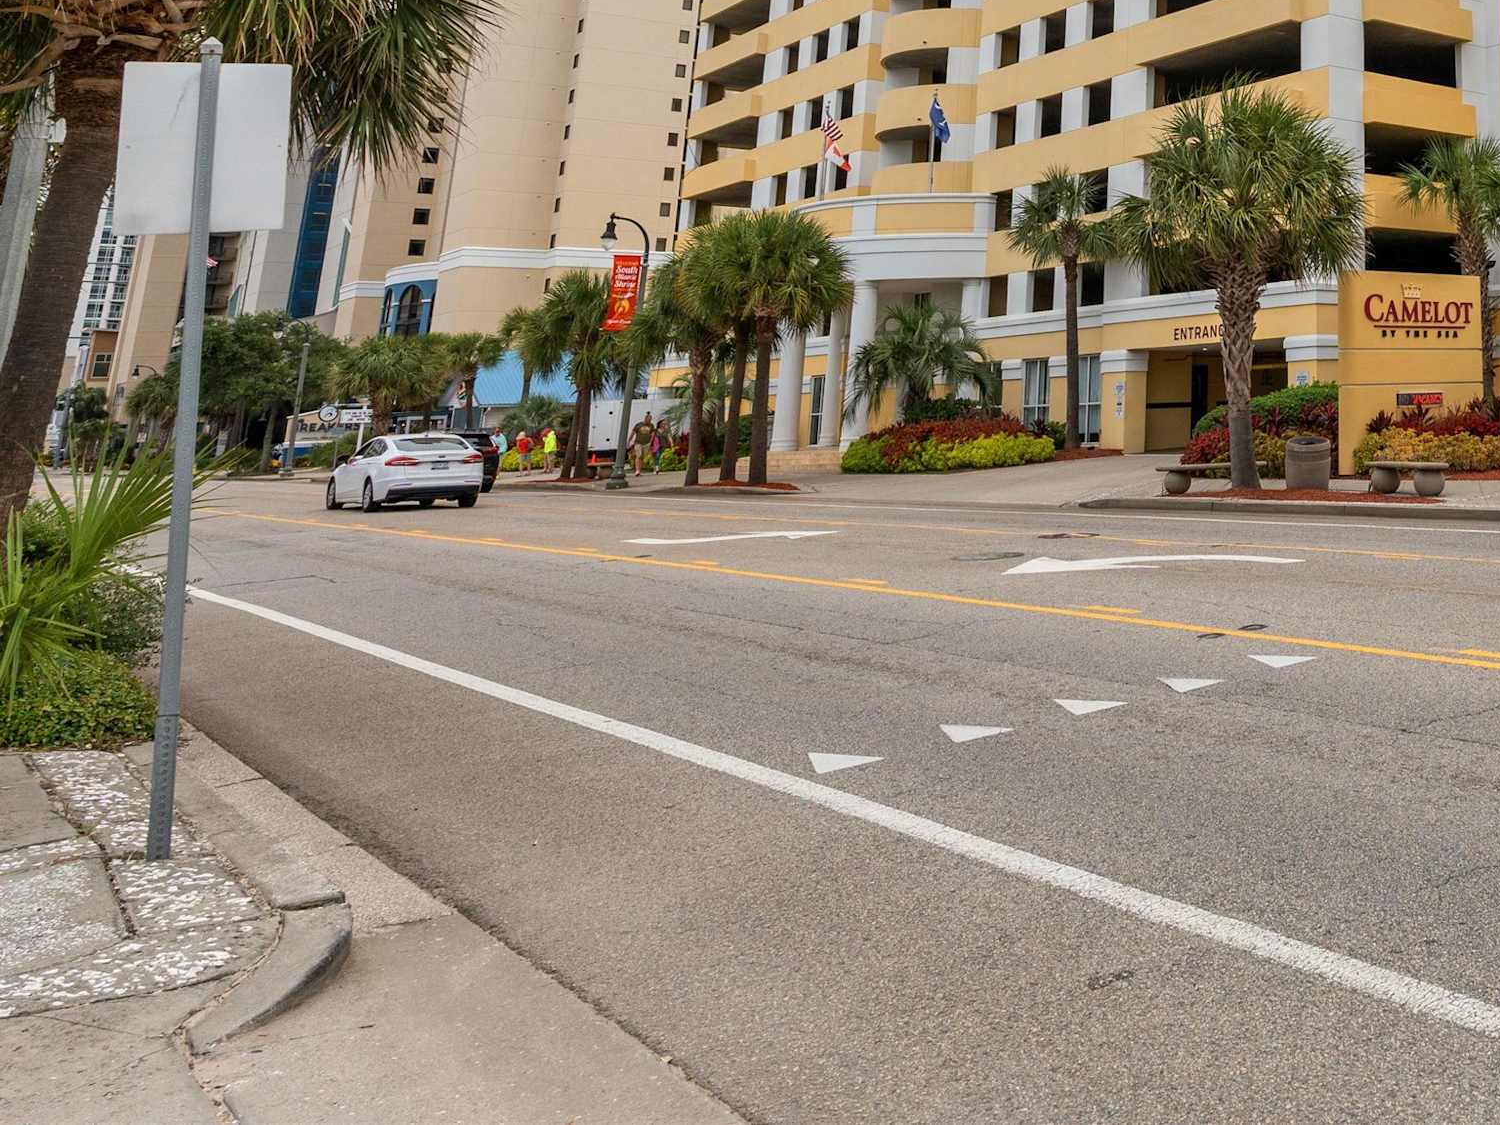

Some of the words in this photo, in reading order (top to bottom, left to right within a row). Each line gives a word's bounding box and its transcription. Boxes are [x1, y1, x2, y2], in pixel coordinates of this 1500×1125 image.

[1364, 293, 1473, 324] CAMELOT
[1174, 325, 1224, 340] ENTRANC
[1381, 330, 1396, 338] BY
[1405, 330, 1428, 338] THE
[1436, 330, 1459, 339] SEA
[295, 421, 361, 432] REAKRS
